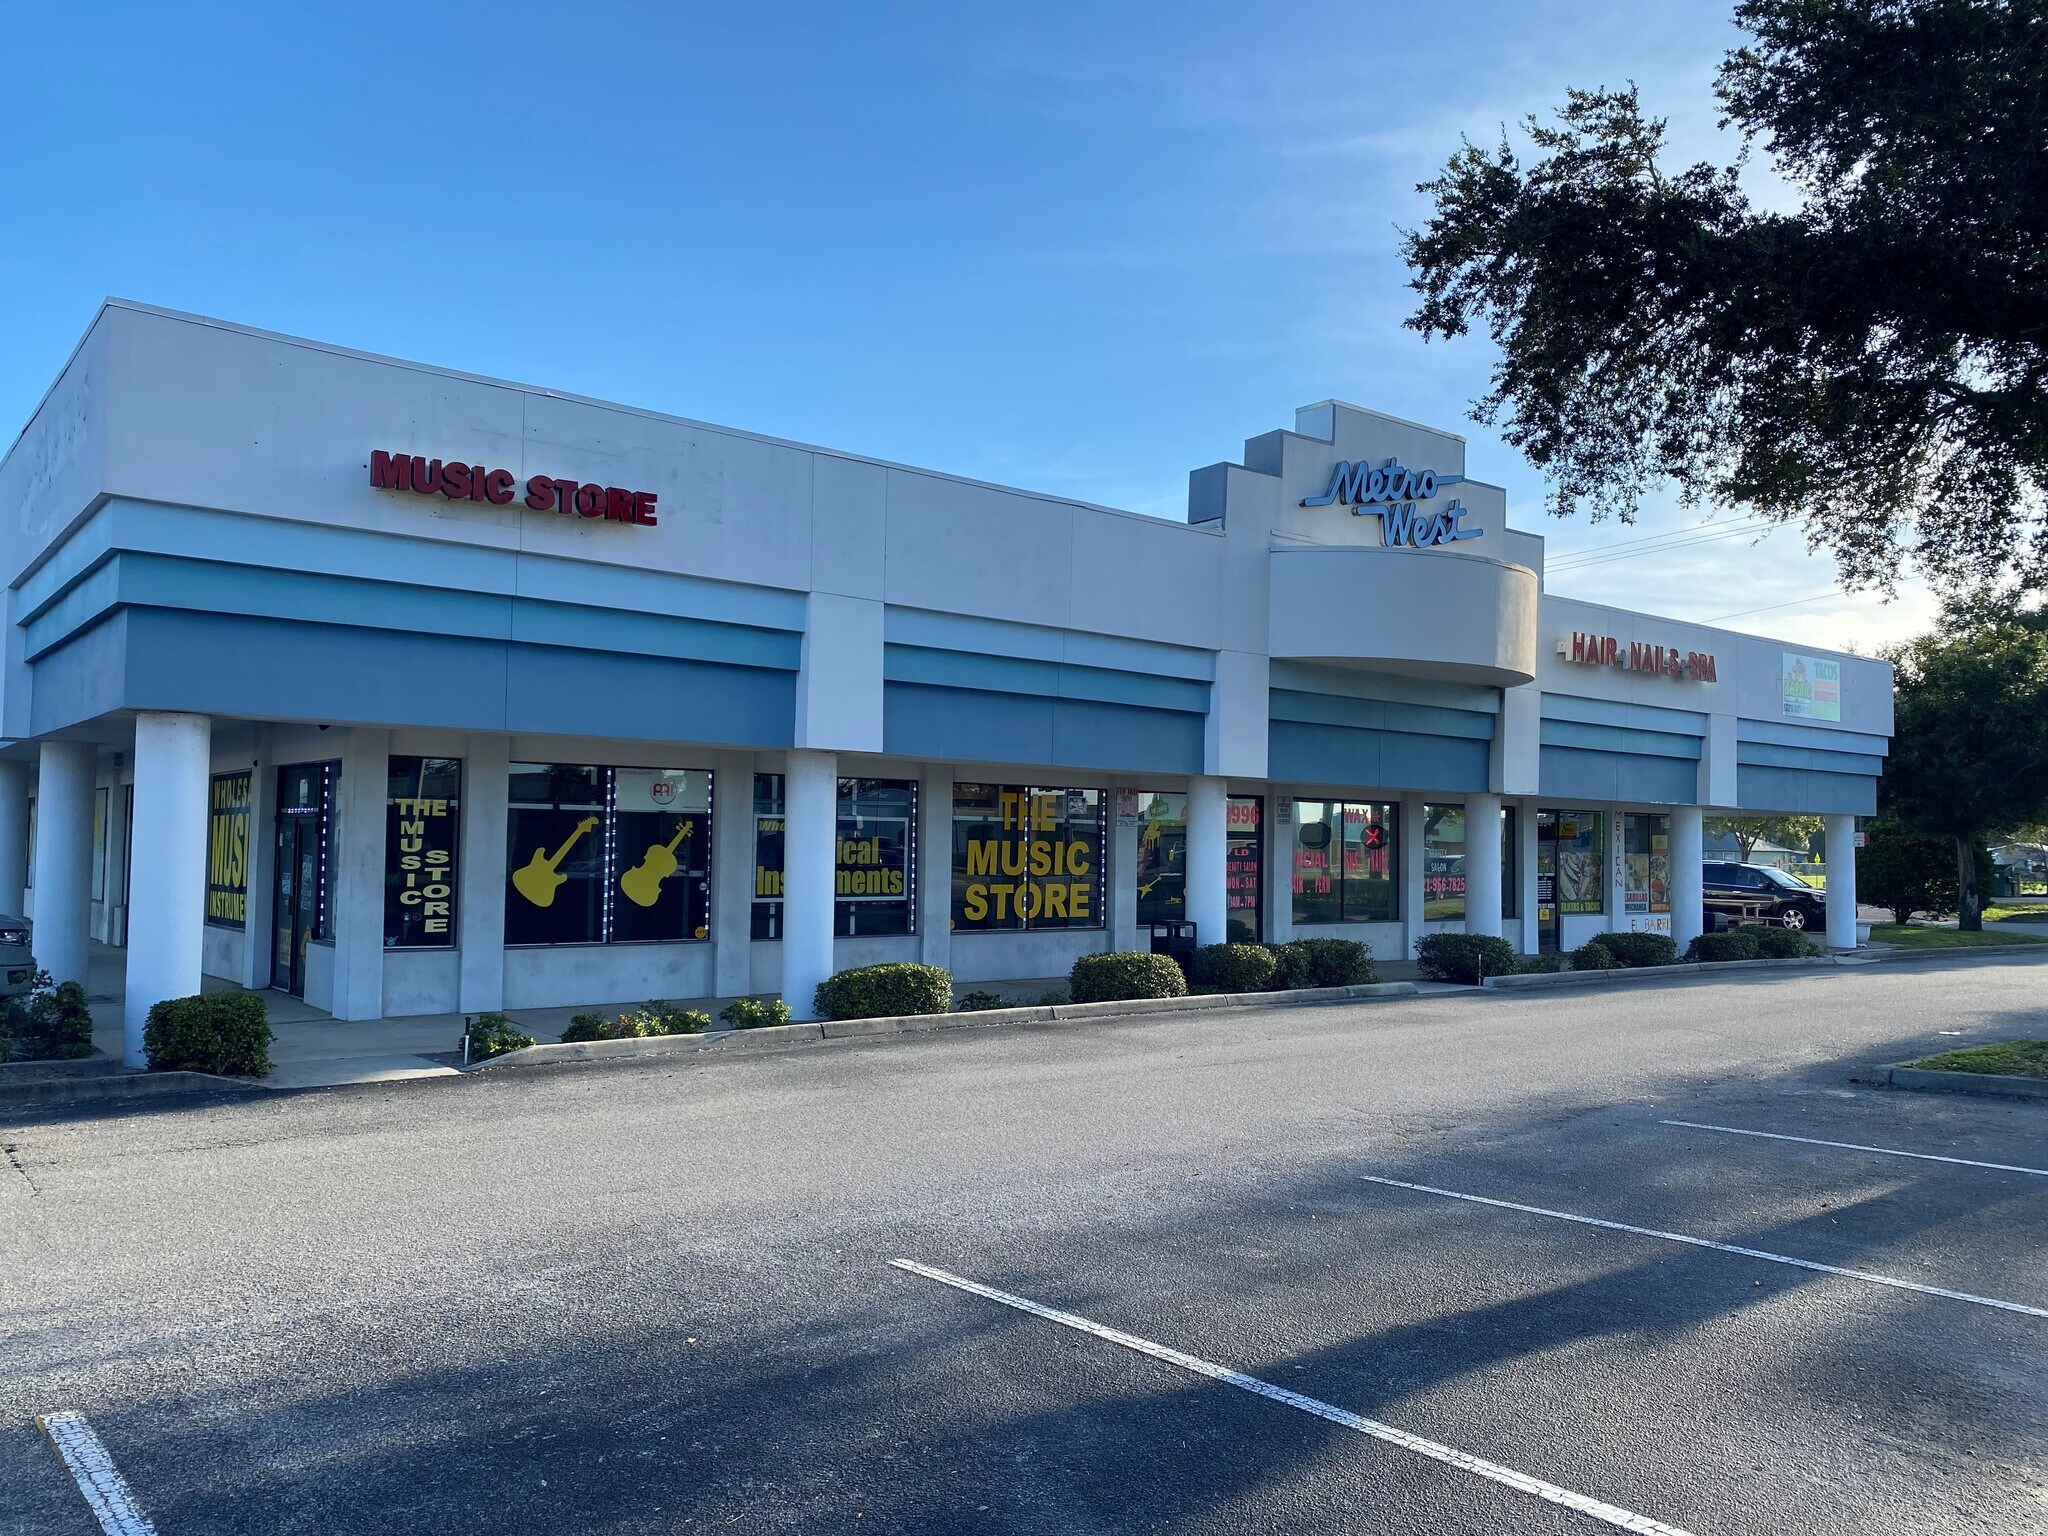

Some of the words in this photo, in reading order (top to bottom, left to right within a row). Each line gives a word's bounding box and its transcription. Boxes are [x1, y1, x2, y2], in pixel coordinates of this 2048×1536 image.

[370, 450, 515, 505] MUSIC
[524, 475, 658, 526] STORE
[1300, 457, 1463, 507] Metro
[1352, 499, 1484, 548] West
[1570, 631, 1618, 667] HAIR
[1629, 641, 1680, 677] NAILS
[1687, 651, 1718, 683] SPA
[395, 798, 448, 817] THE
[999, 792, 1056, 832] THE
[1344, 808, 1370, 824] WAX
[400, 820, 425, 905] MUSIC
[836, 836, 879, 864] ical
[967, 839, 1090, 877] MUSIC
[1234, 848, 1250, 857] LD
[1430, 862, 1447, 873] SALON
[1614, 810, 1623, 888] MEXICAN
[422, 849, 451, 933] STORE
[964, 883, 1091, 921] STORE
[1292, 873, 1304, 894] AIR
[1644, 917, 1671, 932] BARRI
